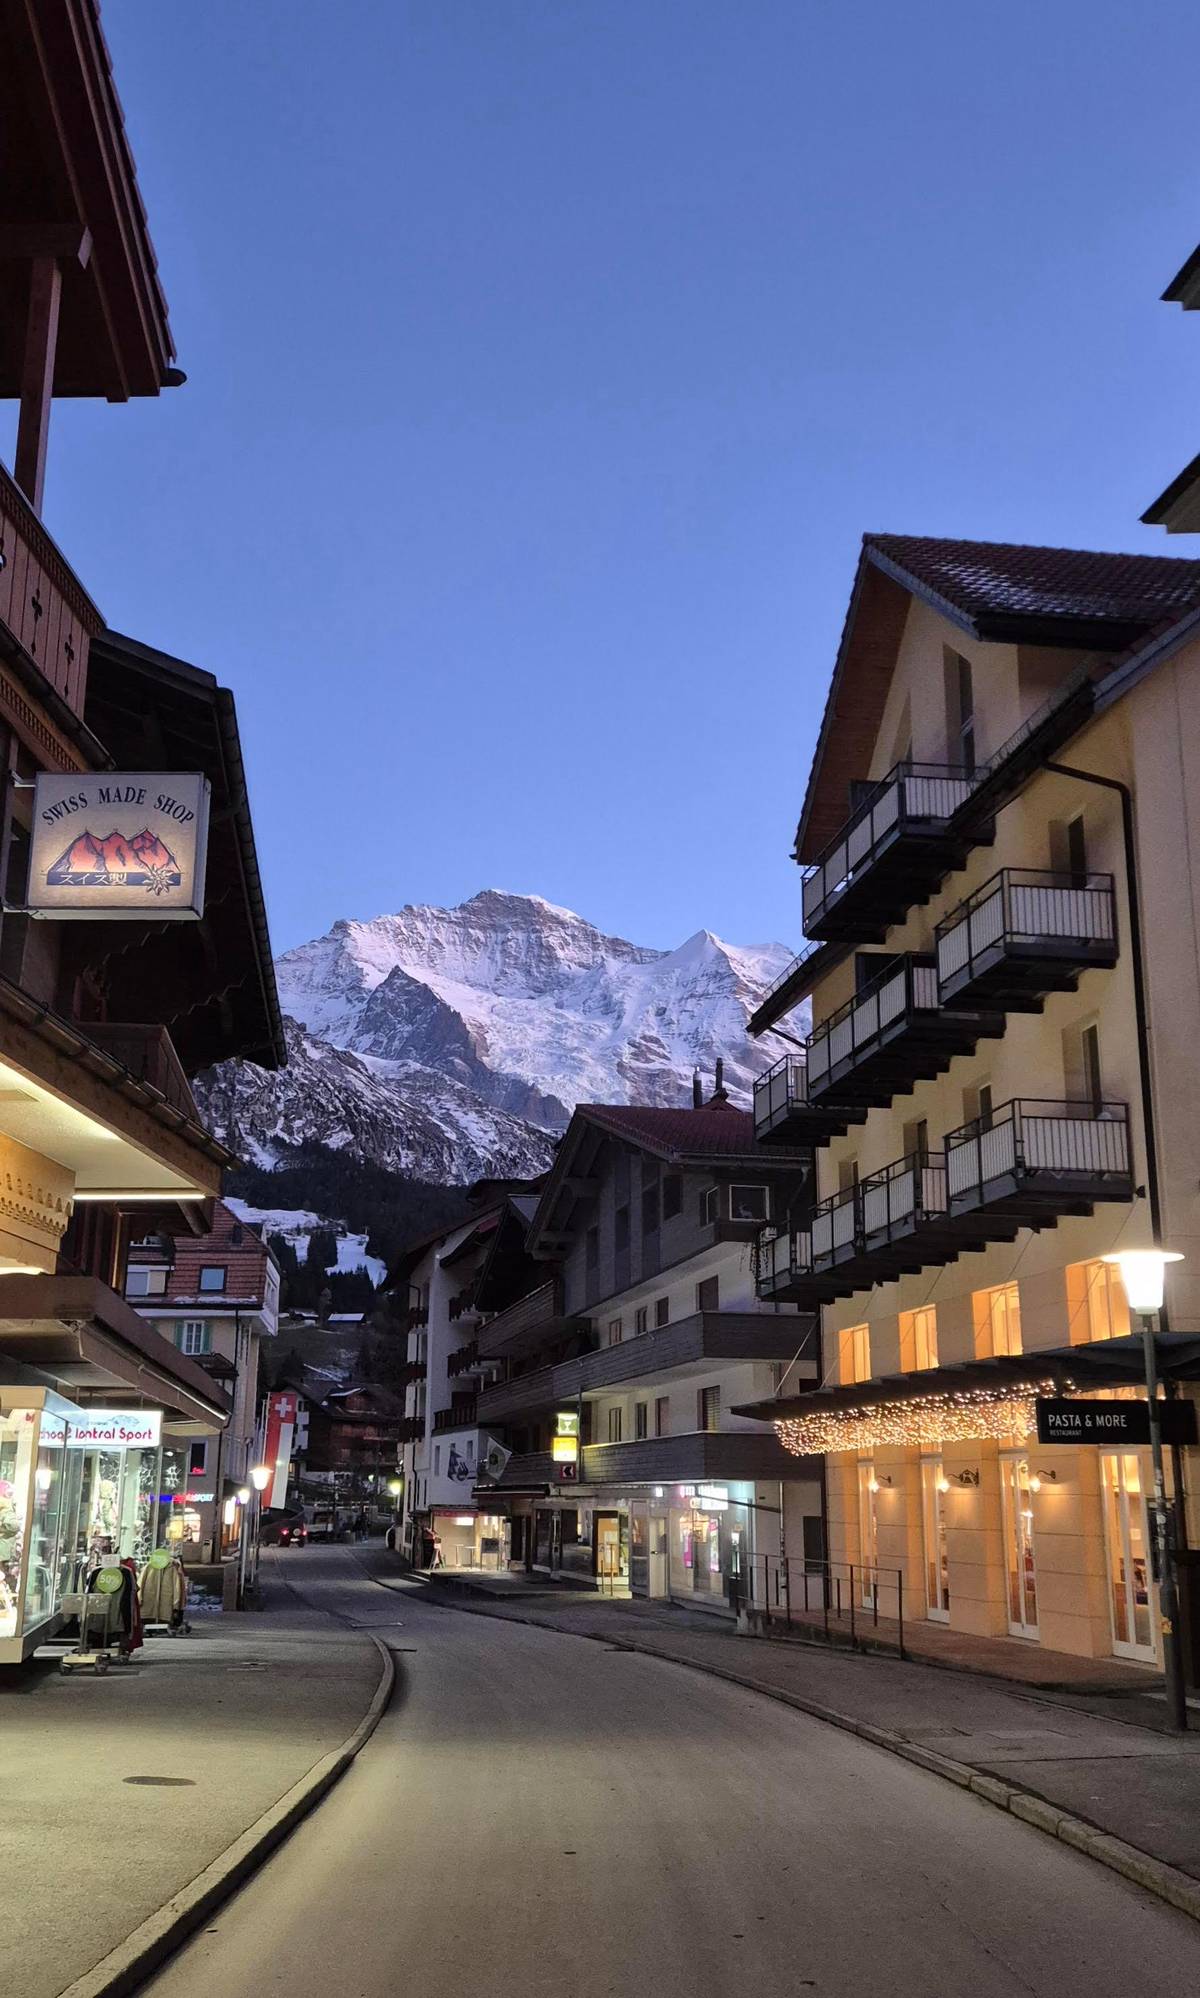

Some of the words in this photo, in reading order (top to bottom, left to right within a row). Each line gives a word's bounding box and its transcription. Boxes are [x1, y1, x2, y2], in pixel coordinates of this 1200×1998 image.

[41, 792, 88, 825] SWISS
[98, 787, 147, 805] MADE
[153, 794, 194, 825] SHOP
[1048, 1415, 1082, 1427] PASTA
[1085, 1415, 1093, 1427] &
[1096, 1414, 1128, 1428] MORE
[119, 1427, 153, 1442] Sport
[1050, 1429, 1082, 1437] RESTAURANT
